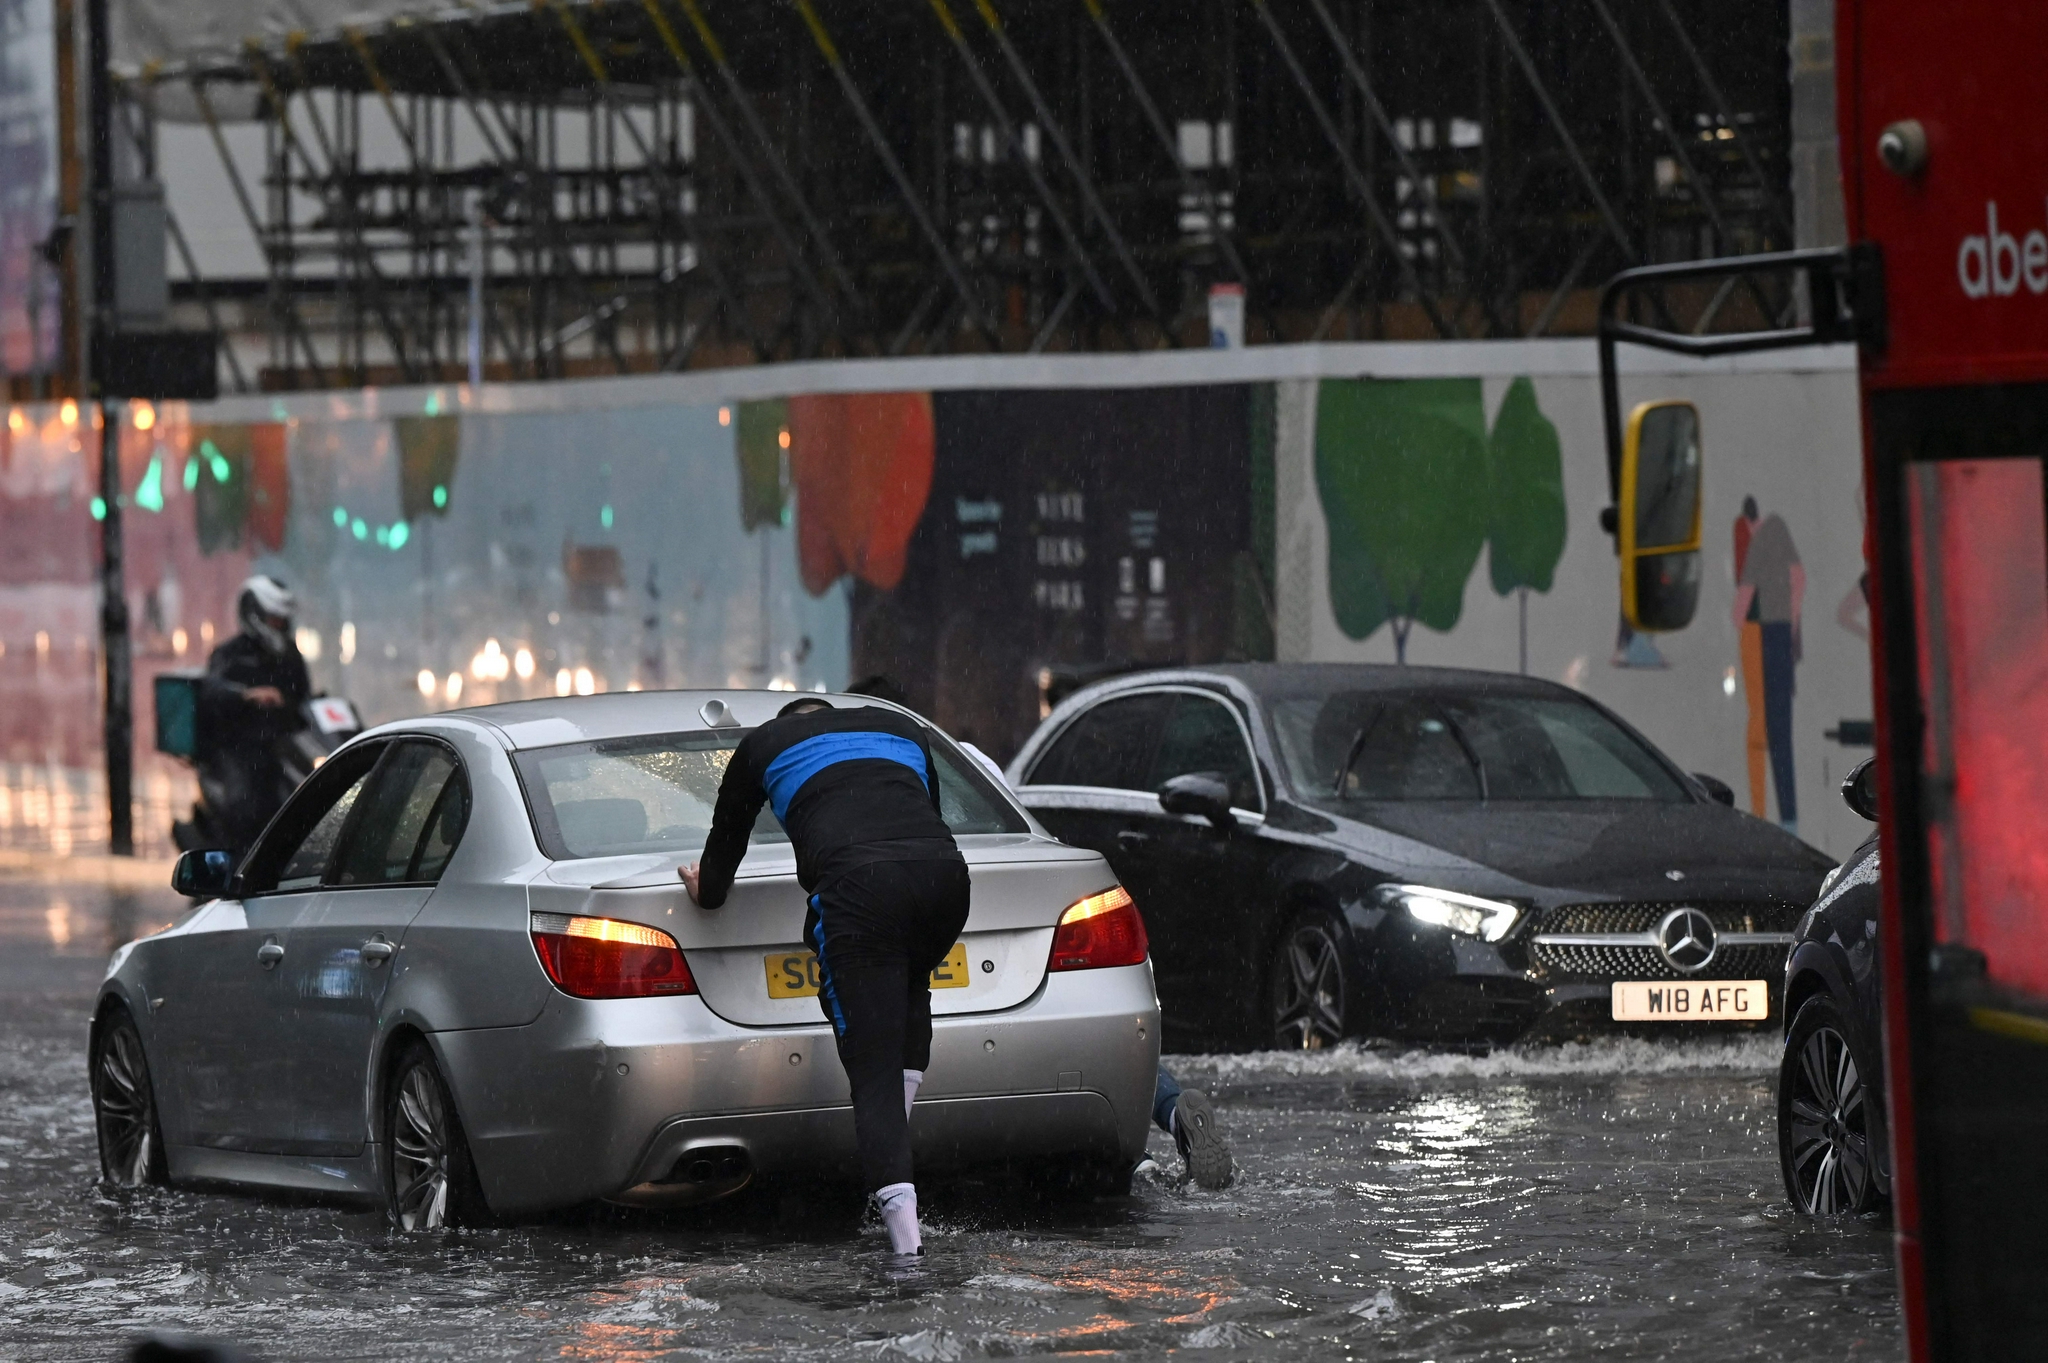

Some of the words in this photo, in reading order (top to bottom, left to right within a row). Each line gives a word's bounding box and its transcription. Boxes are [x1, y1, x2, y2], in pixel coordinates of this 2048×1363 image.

[1957, 196, 2048, 298] abe
[1648, 988, 1690, 1013] W18
[1700, 988, 1749, 1013] AFG
